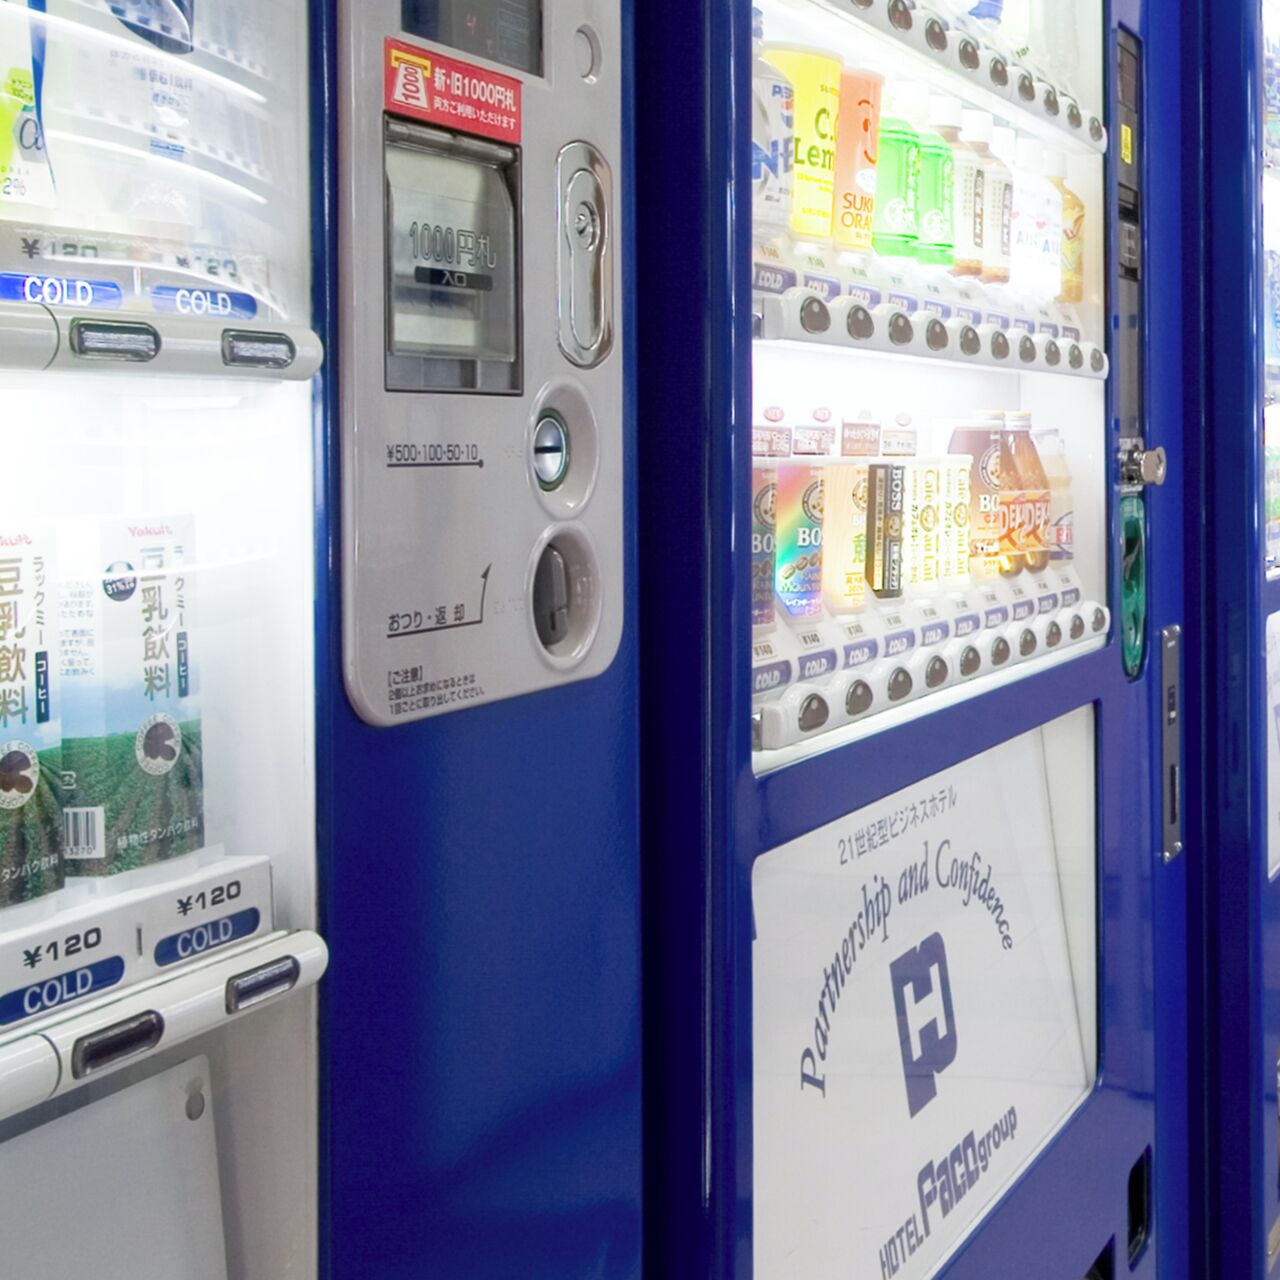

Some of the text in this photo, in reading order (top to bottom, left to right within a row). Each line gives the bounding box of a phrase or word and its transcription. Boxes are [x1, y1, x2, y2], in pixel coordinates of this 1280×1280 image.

[401, 67, 421, 102] 1000
[433, 66, 517, 112] 新・旧1000円札
[433, 96, 517, 130] 両方ご利用いただけます
[409, 221, 496, 269] 1000円札
[24, 276, 94, 307] COLD
[441, 270, 467, 287] 入口
[176, 289, 232, 315] COLD
[128, 524, 173, 537] Yakult
[140, 545, 172, 701] 豆乳飲料
[178, 639, 188, 689] コーヒー
[805, 658, 828, 677] COLD
[850, 647, 870, 664] COLD
[37, 660, 47, 714] コーヒー
[756, 670, 780, 689] COLD
[838, 784, 958, 866] 21世紀型ビジネスホテル
[176, 880, 242, 916] ¥120
[22, 926, 102, 969] ¥120
[177, 918, 234, 958] COLD
[801, 838, 1014, 1099] Partnership and Confidence
[23, 968, 93, 1014] COLD
[977, 1105, 1019, 1174] group
